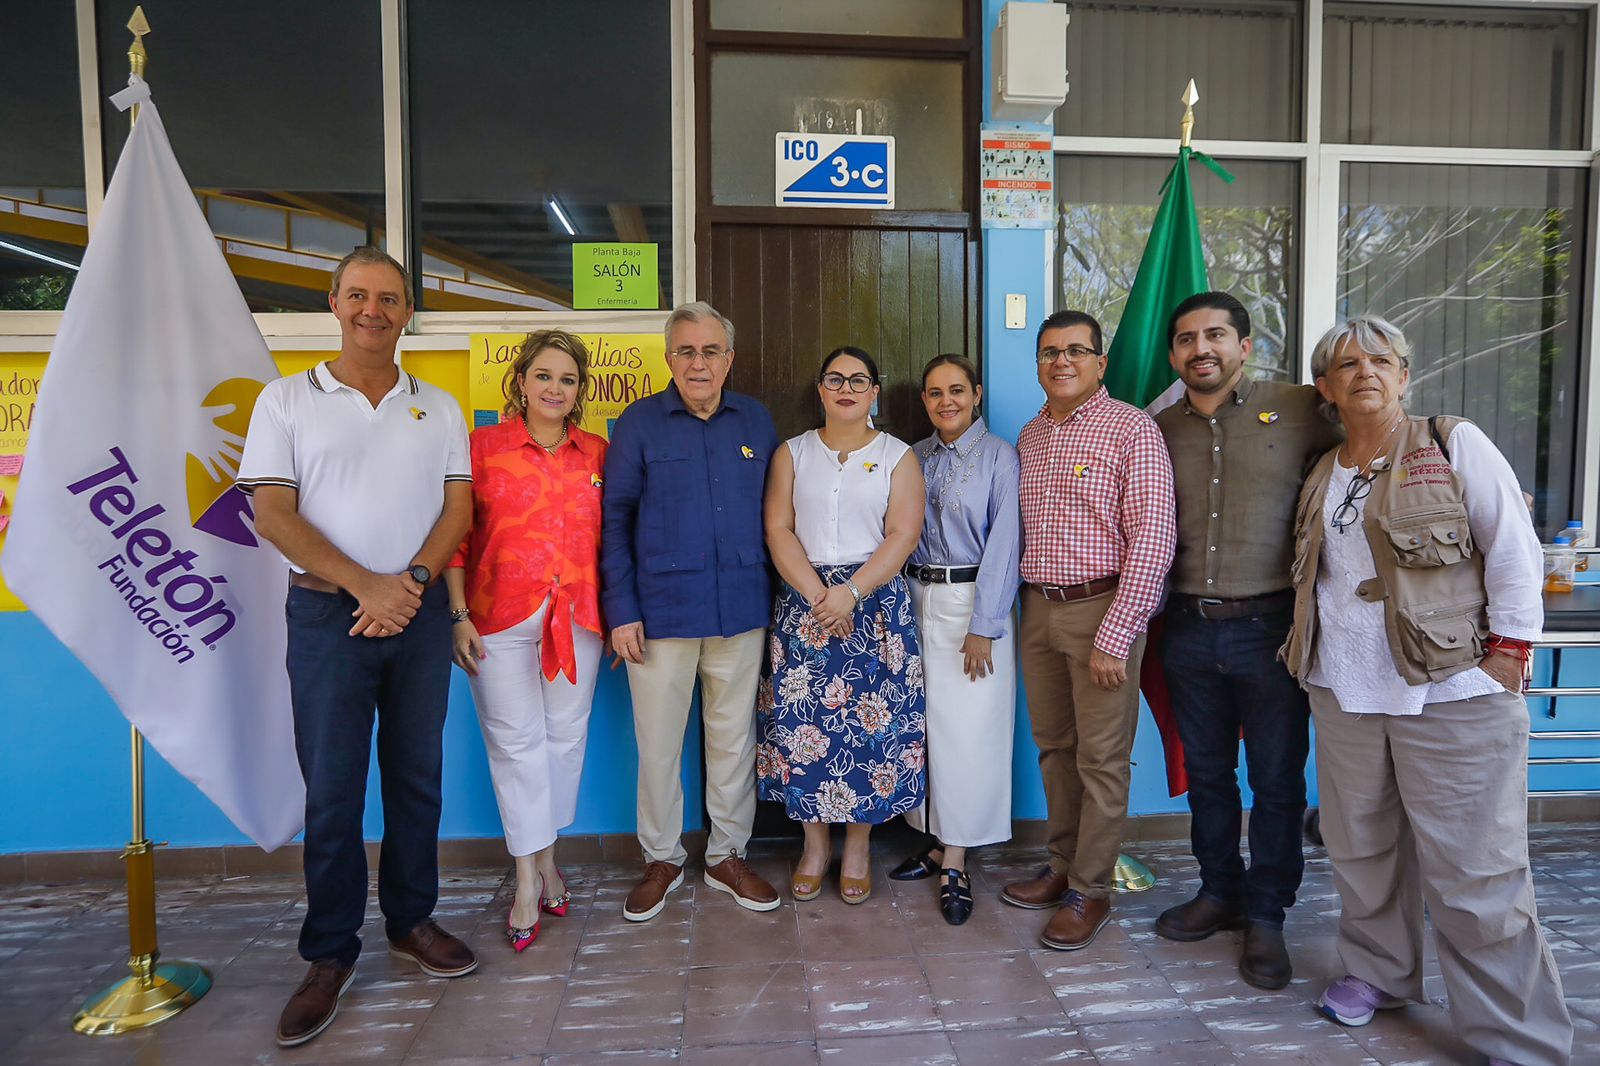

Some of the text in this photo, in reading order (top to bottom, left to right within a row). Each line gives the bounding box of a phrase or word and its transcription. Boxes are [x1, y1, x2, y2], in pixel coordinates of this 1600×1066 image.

[784, 139, 819, 161] ICO
[1004, 141, 1031, 149] SISMO
[998, 180, 1037, 189] INCENDIO
[593, 247, 641, 258] Planta Baja
[593, 260, 641, 278] SALÓN
[615, 279, 623, 292] 3
[1413, 451, 1442, 460] NACIÓ
[1409, 468, 1450, 476] MÉXICO
[66, 446, 236, 646] Teletón
[98, 553, 195, 664] Fundación
